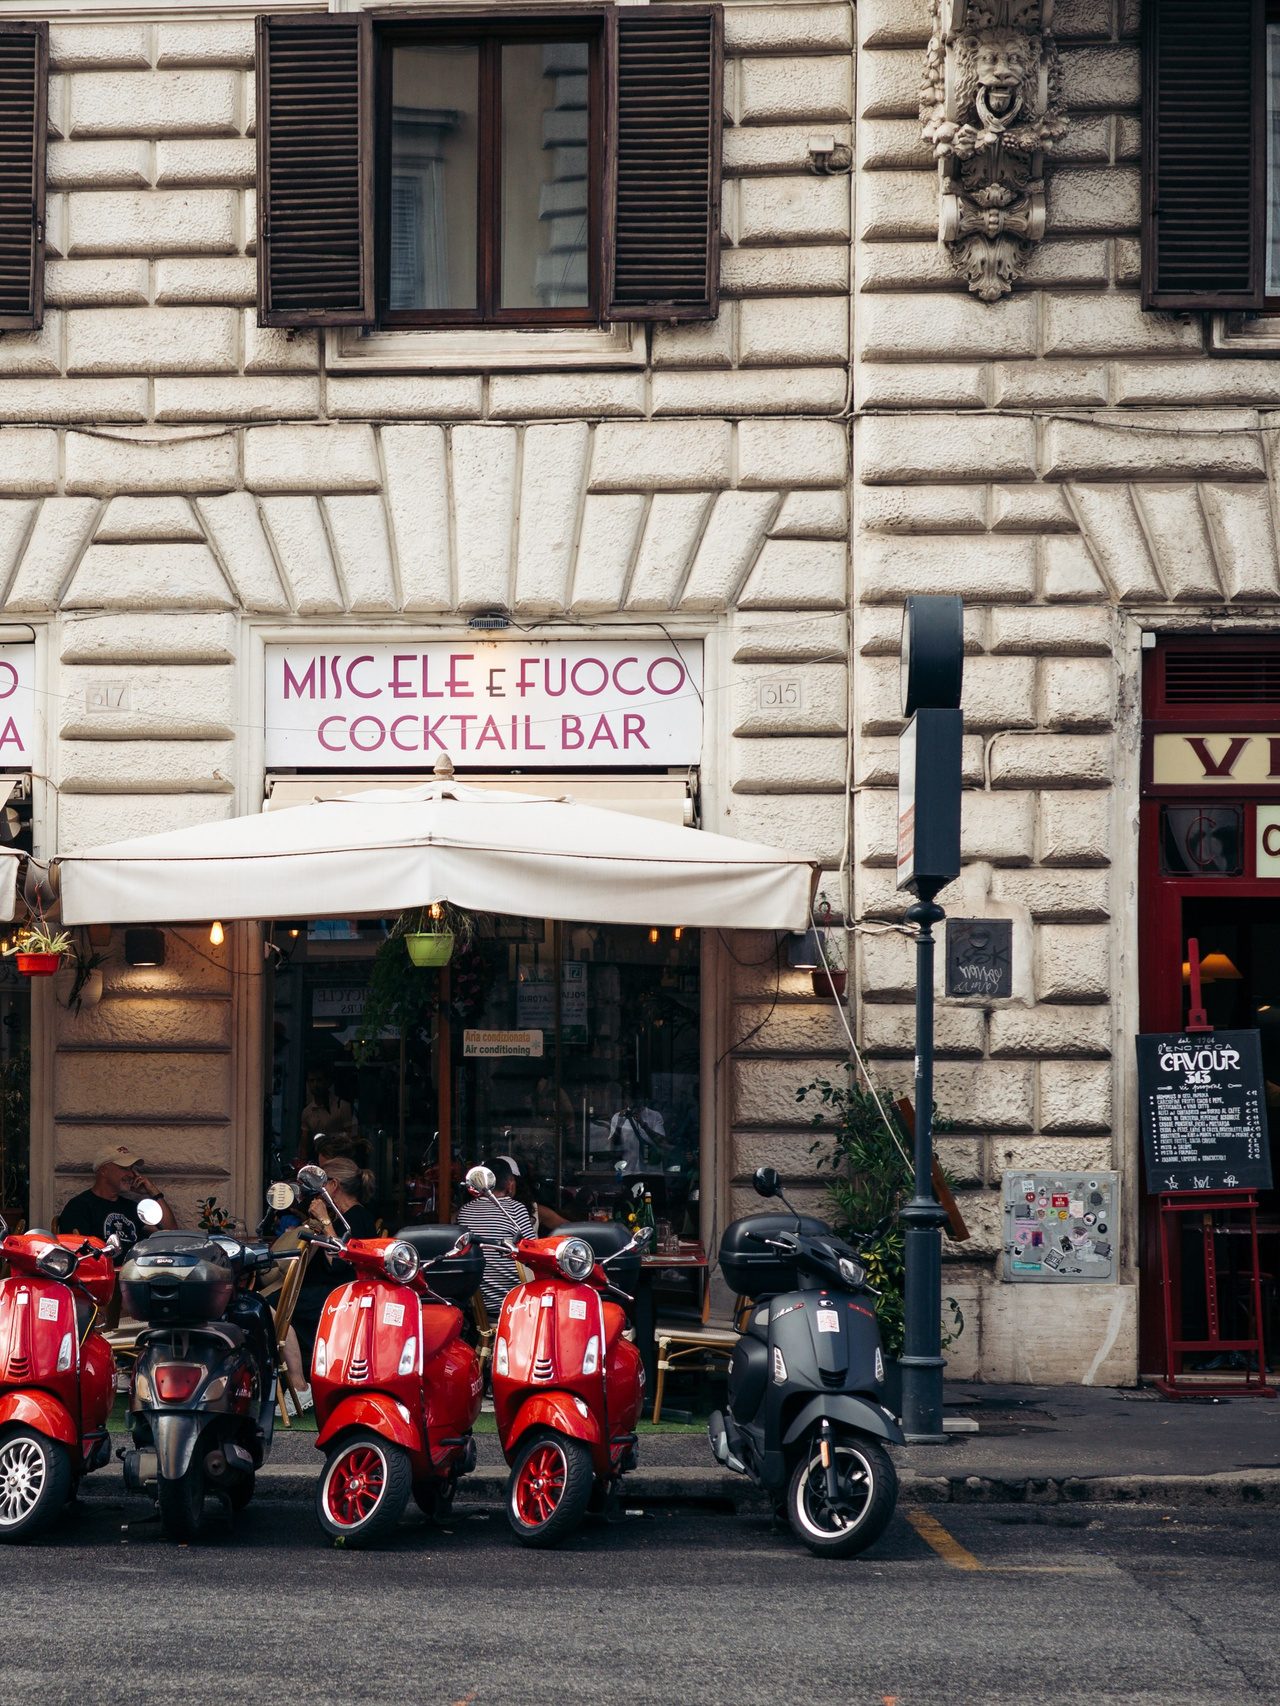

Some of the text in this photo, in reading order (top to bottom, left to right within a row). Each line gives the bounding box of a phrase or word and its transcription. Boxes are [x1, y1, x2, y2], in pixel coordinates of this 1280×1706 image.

[283, 654, 686, 699] MISCELE E FUOCO
[89, 687, 125, 707] 317
[761, 683, 797, 705] 315
[317, 713, 651, 751] COCKTAIL BAR
[465, 1030, 531, 1043] Aria condizionata
[465, 1044, 531, 1056] Air conditioning
[1160, 1050, 1241, 1071] CAVOUR
[1184, 1070, 1211, 1084] 313
